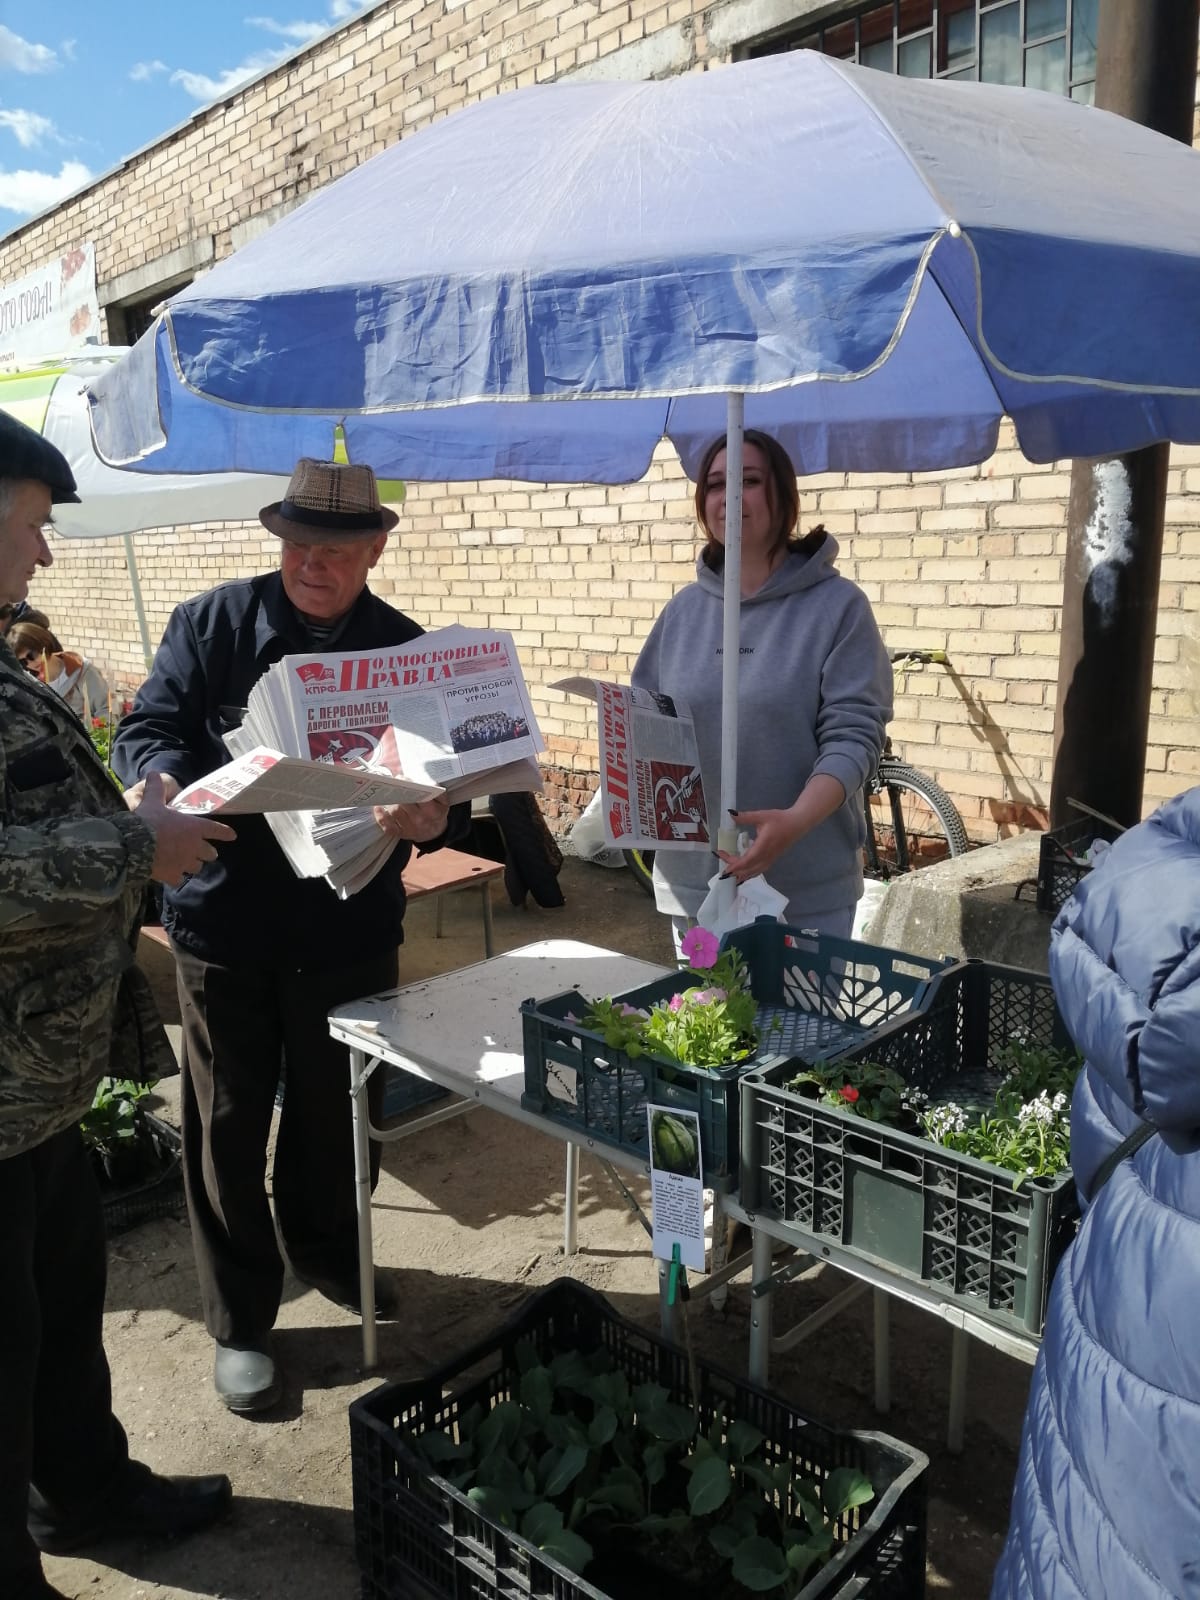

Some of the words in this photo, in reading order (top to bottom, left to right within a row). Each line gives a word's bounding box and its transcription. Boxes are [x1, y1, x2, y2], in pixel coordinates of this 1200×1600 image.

[738, 647, 755, 655] ORK
[304, 685, 337, 695] КПРФ
[446, 685, 480, 698] ПРОТИВ
[481, 679, 513, 691] НОВОЙ
[465, 691, 499, 703] УГРОЗЫ
[307, 708, 315, 721] С
[307, 719, 341, 733] ДОРОГИЕ
[345, 714, 389, 728] ТОВАРИЩИ!
